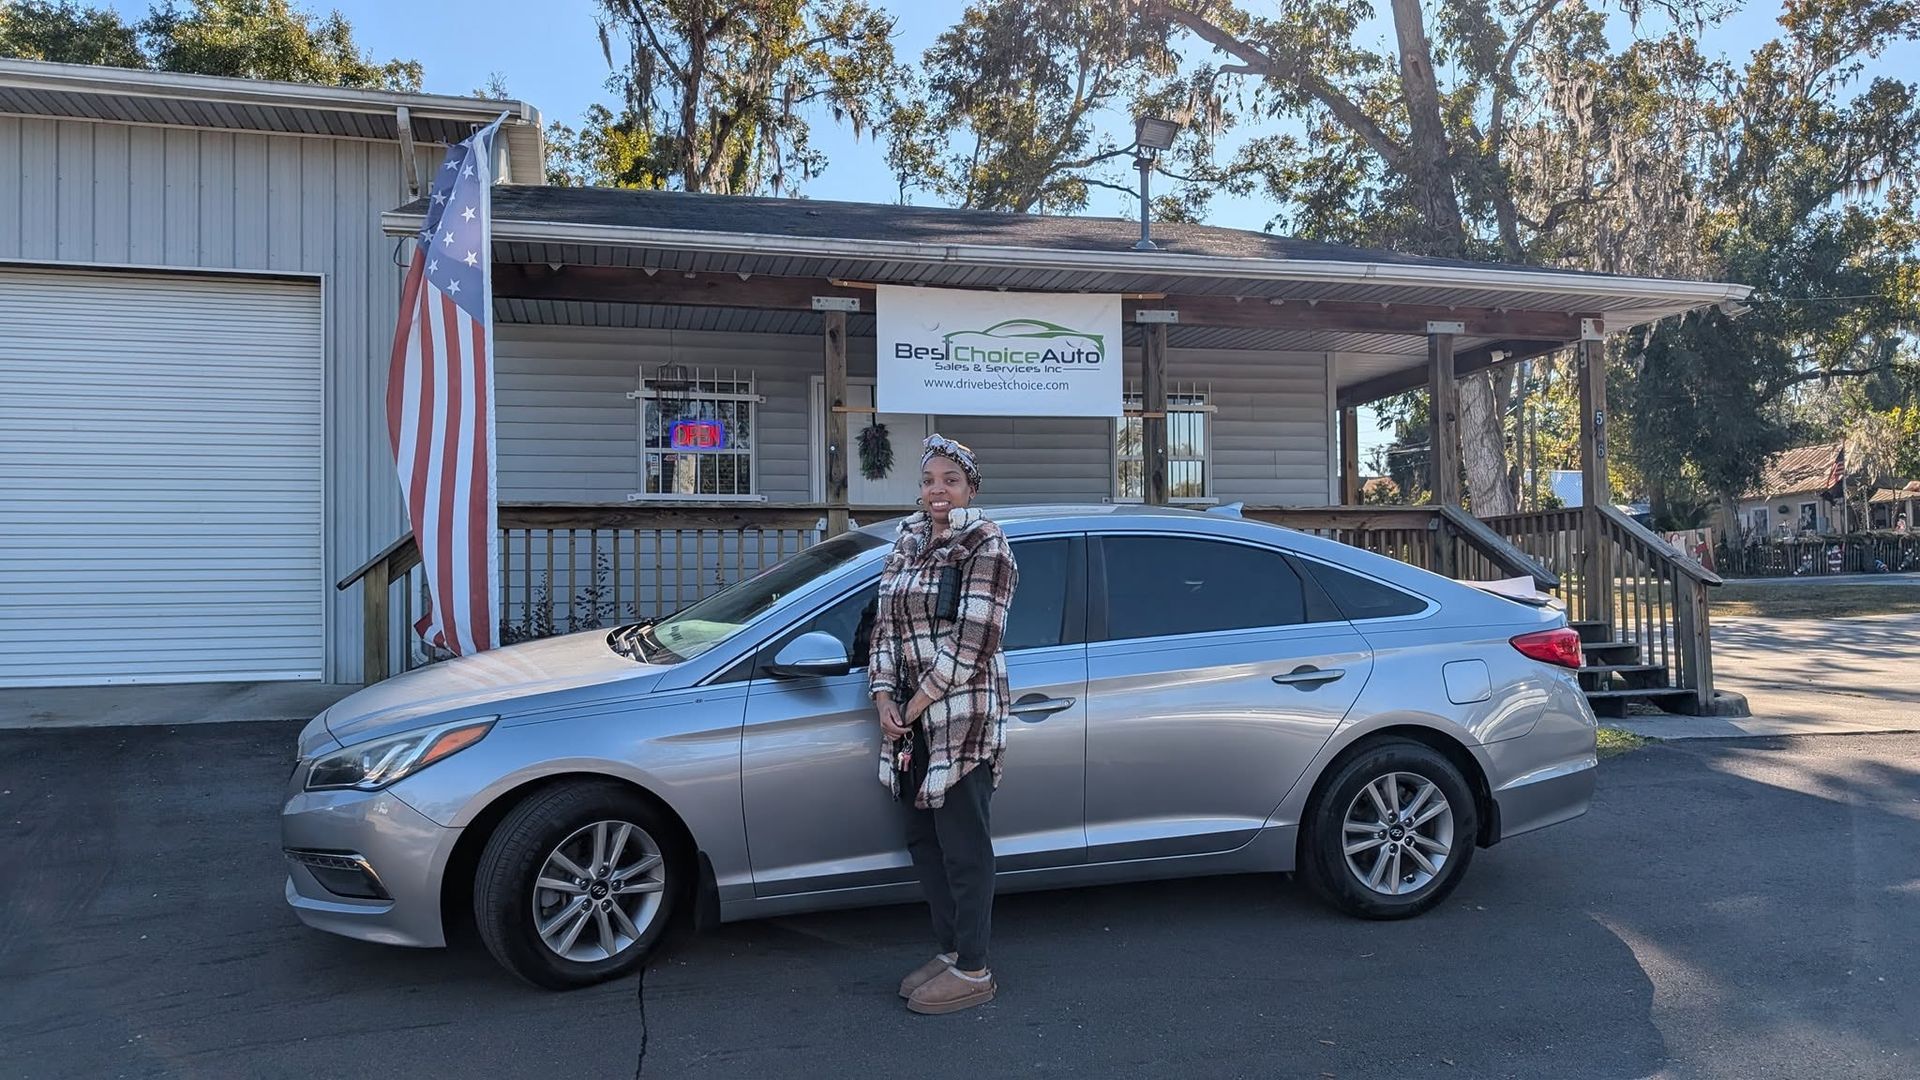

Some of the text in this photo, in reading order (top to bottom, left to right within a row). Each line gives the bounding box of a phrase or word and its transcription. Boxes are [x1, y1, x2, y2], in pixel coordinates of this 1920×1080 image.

[935, 362, 1062, 373] Sales & Services Inc
[923, 378, 1069, 390] www.drivebestchoice.com
[674, 424, 721, 447] OPEN
